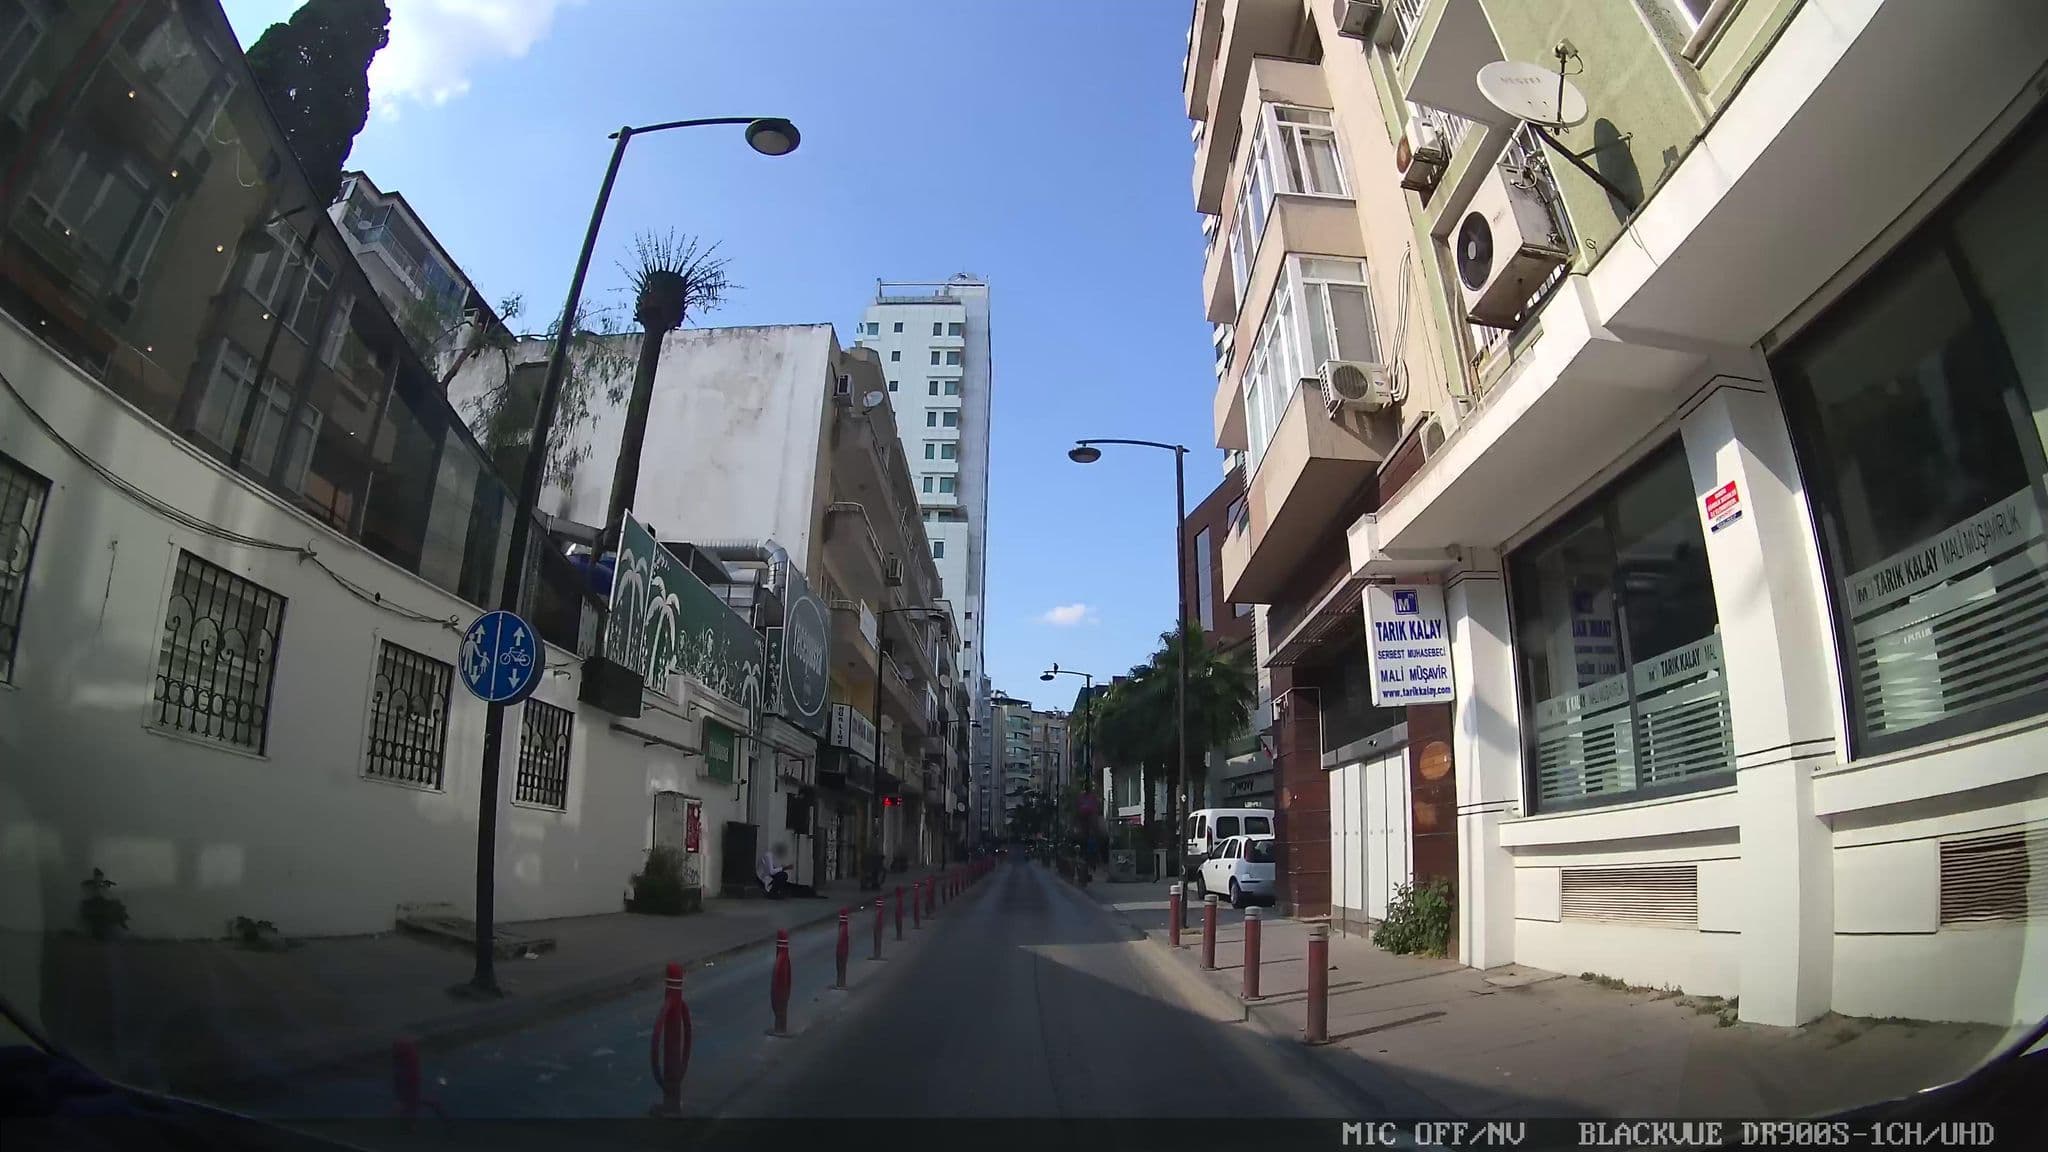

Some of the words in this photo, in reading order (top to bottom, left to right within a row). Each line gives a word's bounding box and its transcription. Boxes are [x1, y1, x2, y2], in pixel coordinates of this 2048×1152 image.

[1873, 564, 1905, 597] TARIK
[1905, 547, 1940, 583] KALAY
[1376, 621, 1407, 641] TARIK
[1409, 619, 1442, 640] KALAY
[1377, 649, 1405, 660] SERBEST
[1679, 647, 1701, 672] KALAY
[1380, 666, 1404, 683] MALİ
[1410, 665, 1447, 683] MÜŞAVİR
